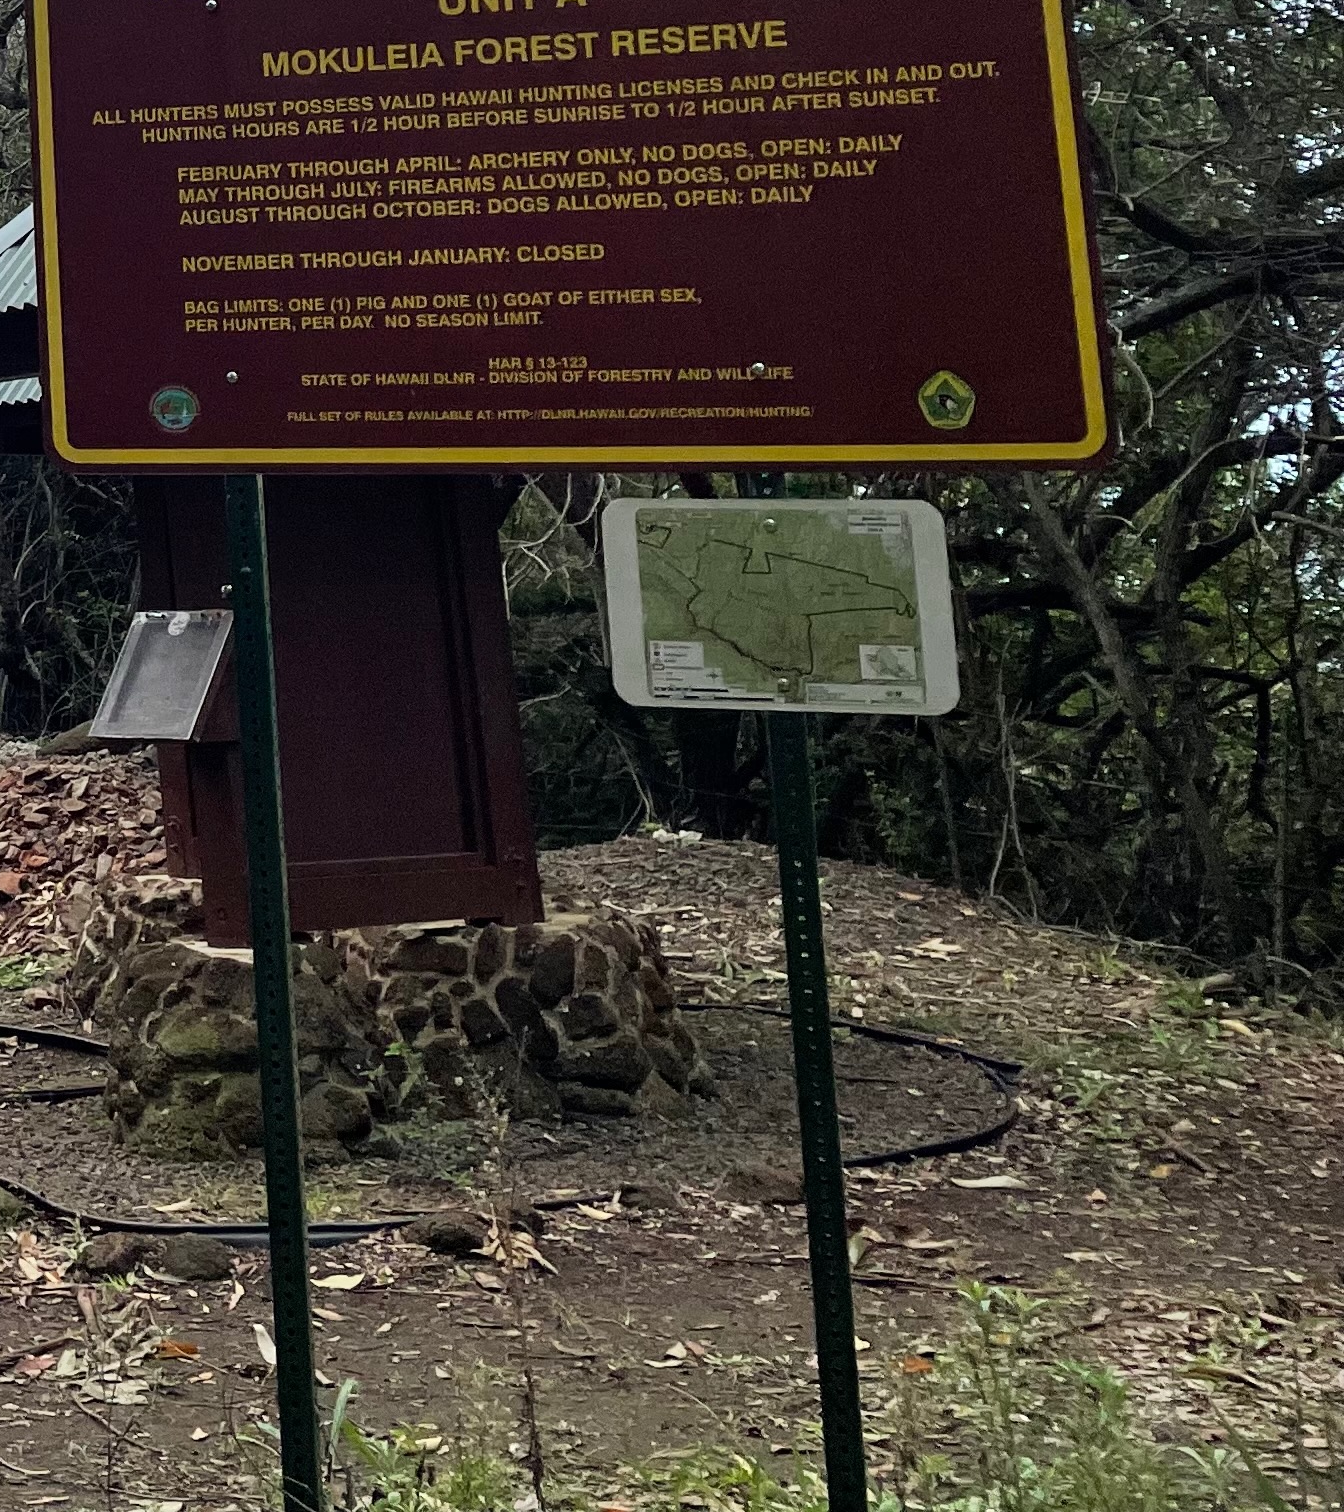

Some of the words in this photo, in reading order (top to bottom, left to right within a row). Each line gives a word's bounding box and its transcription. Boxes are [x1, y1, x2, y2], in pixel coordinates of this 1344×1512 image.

[263, 42, 444, 76] MOKULEIA
[455, 31, 598, 65] FOREST
[611, 19, 787, 55] RESERVE
[93, 110, 126, 125] ALL
[131, 105, 218, 123] HUNTERS
[224, 102, 276, 118] MUST
[283, 96, 373, 115] POSSESS
[379, 93, 435, 110] VALID
[442, 89, 512, 106] HAWAII
[519, 83, 612, 103] HUNTING
[619, 77, 723, 97] LICENSES
[731, 74, 775, 91] AND
[782, 70, 860, 89] CHECK
[867, 67, 888, 84] IN
[896, 64, 942, 82] AND
[950, 61, 999, 79] OUT.
[143, 125, 226, 142] HUNTING
[232, 121, 299, 138] HOURS
[306, 119, 344, 135] ARE
[351, 117, 377, 133] 1/2
[384, 114, 440, 131] HOUR
[447, 109, 528, 128] BEFORE
[534, 104, 625, 123] SUNRISE
[631, 102, 659, 118] TO
[667, 101, 695, 117] 1/2
[703, 97, 764, 114] HOUR
[772, 92, 841, 111] AFTER
[849, 87, 939, 107] SUNSET.
[178, 164, 282, 182] FEBRUARY
[287, 159, 389, 178] THROUGH
[396, 156, 461, 173] APRIL:
[469, 151, 570, 170] ARCHERY
[577, 147, 635, 165] ONLY,
[643, 145, 675, 162] NO
[683, 142, 753, 160] DOGS,
[761, 138, 830, 157] OPEN:
[839, 134, 902, 153] DAILY
[179, 188, 218, 204] MAY
[225, 184, 324, 201] THROUGH
[331, 181, 381, 198] JULY:
[389, 176, 495, 195] FIREARMS
[503, 171, 611, 190] ALLOWED,
[619, 169, 650, 186] NO
[658, 166, 728, 184] DOGS,
[736, 163, 805, 181] OPEN:
[814, 160, 877, 178] DAILY
[180, 207, 259, 225] AUGUST
[265, 204, 366, 222] THROUGH
[373, 199, 481, 218] OCTOBER:
[488, 196, 549, 214] DOGS
[557, 192, 667, 211] ALLOWED,
[675, 189, 743, 207] OPEN:
[751, 185, 812, 204] DAILY
[183, 254, 294, 272] NOVEMBER
[300, 250, 402, 268] THROUGH
[409, 247, 509, 265] JANUARY:
[517, 243, 604, 262] CLOSED
[185, 300, 219, 314] BAG
[225, 298, 283, 313] LIMITS:
[289, 297, 325, 312] ONE
[331, 297, 350, 314] (1)
[357, 296, 385, 310] PIG
[391, 295, 427, 309] AND
[433, 294, 471, 309] ONE
[477, 293, 497, 311] (1)
[504, 291, 553, 307] GOAT
[558, 291, 582, 305] OF
[589, 289, 654, 305] EITHER
[660, 288, 701, 304] SEX,
[185, 318, 217, 332] PER
[223, 317, 295, 332] HUNTER,
[302, 315, 334, 330] PER
[385, 314, 410, 328] NO
[416, 312, 488, 327] SEASON
[494, 310, 543, 326] LIMIT.
[302, 373, 346, 386] STATE
[351, 373, 370, 386] OF
[376, 372, 429, 385] HAWAII
[434, 372, 475, 385] DLNR
[489, 371, 558, 384] DIVISION
[562, 370, 583, 383] OF
[588, 369, 672, 382] FORESTRY
[678, 368, 712, 381] AND
[488, 357, 522, 370] HAR
[525, 356, 534, 371] §
[539, 356, 588, 370] 13-123
[287, 411, 316, 422] FULL
[319, 411, 341, 422] SET
[345, 411, 361, 421] OF
[365, 410, 404, 421] RULES
[408, 410, 473, 421] AVAILABLE
